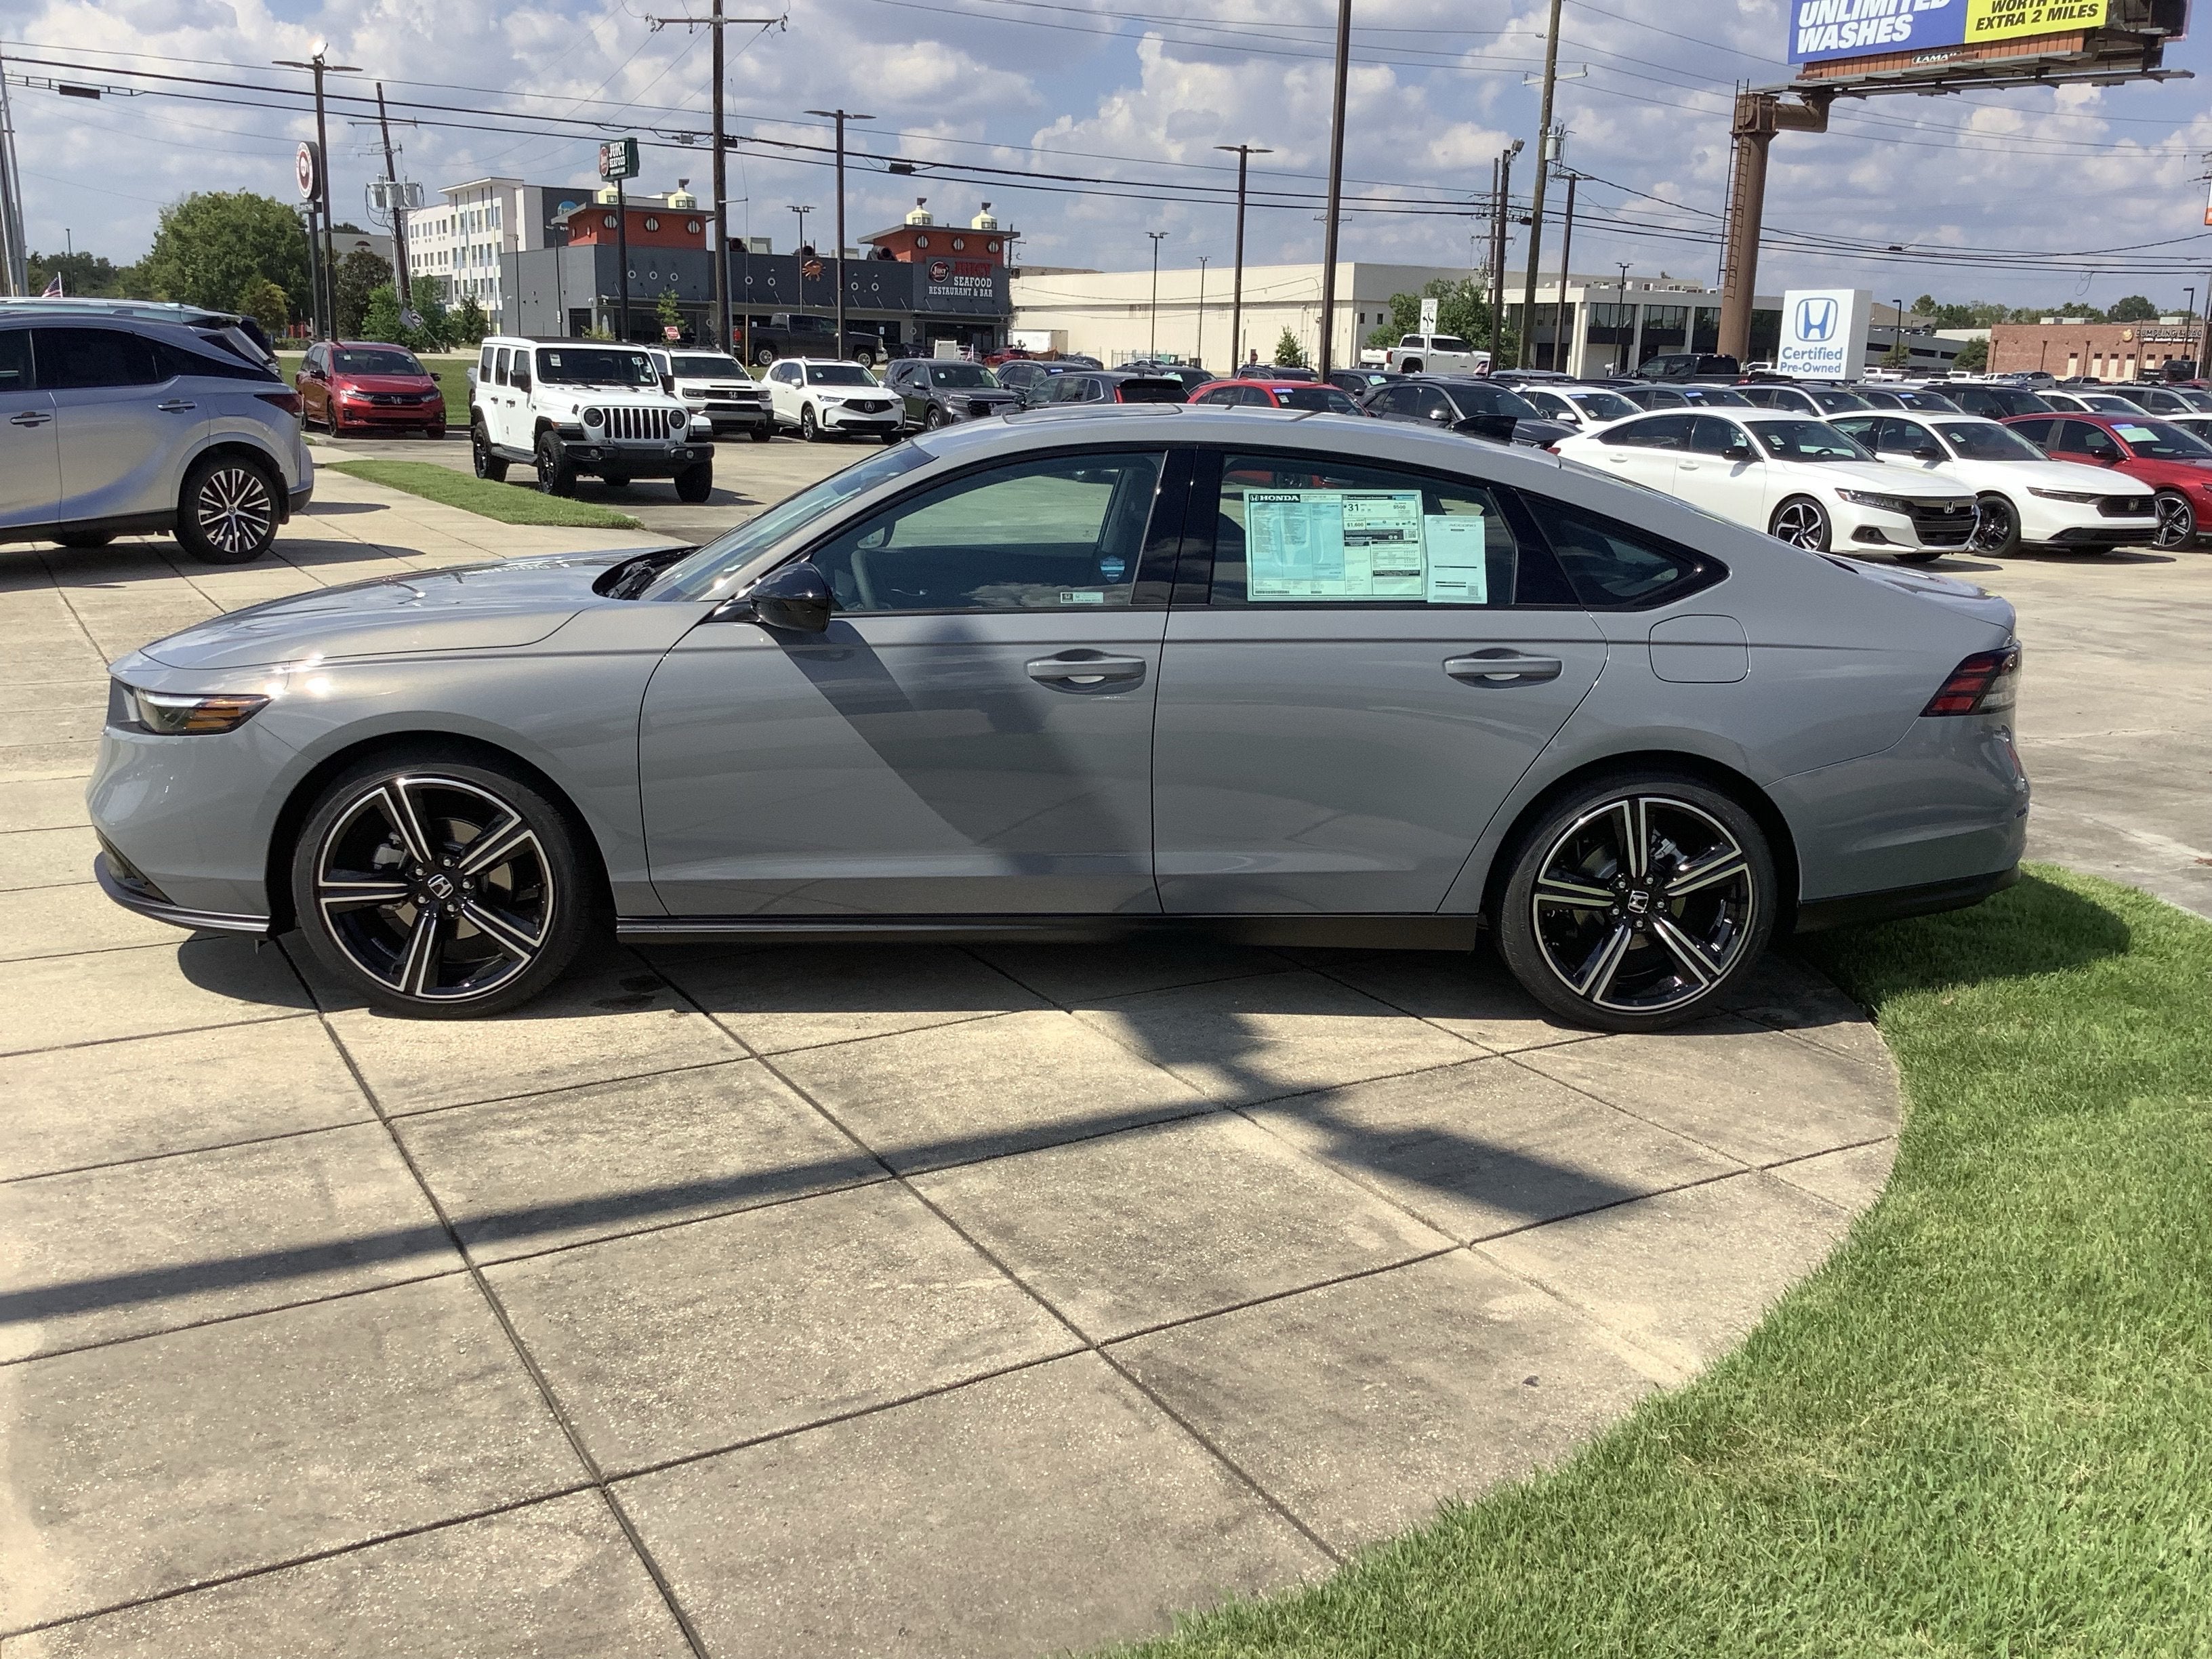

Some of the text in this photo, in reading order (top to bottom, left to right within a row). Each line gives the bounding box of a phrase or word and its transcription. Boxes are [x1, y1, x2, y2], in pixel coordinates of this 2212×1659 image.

[1975, 3, 2099, 31] EXTRA 2 MILES
[1797, 14, 1914, 54] WASHES
[609, 141, 626, 158] JUICY
[954, 276, 992, 287] SEAFOOD
[928, 286, 993, 298] RESTAURANT & BAR
[2135, 329, 2177, 337] DUMPLING
[1782, 346, 1843, 360] Certified
[1780, 362, 1841, 373] Pre-Owned
[1348, 504, 1359, 512] 31
